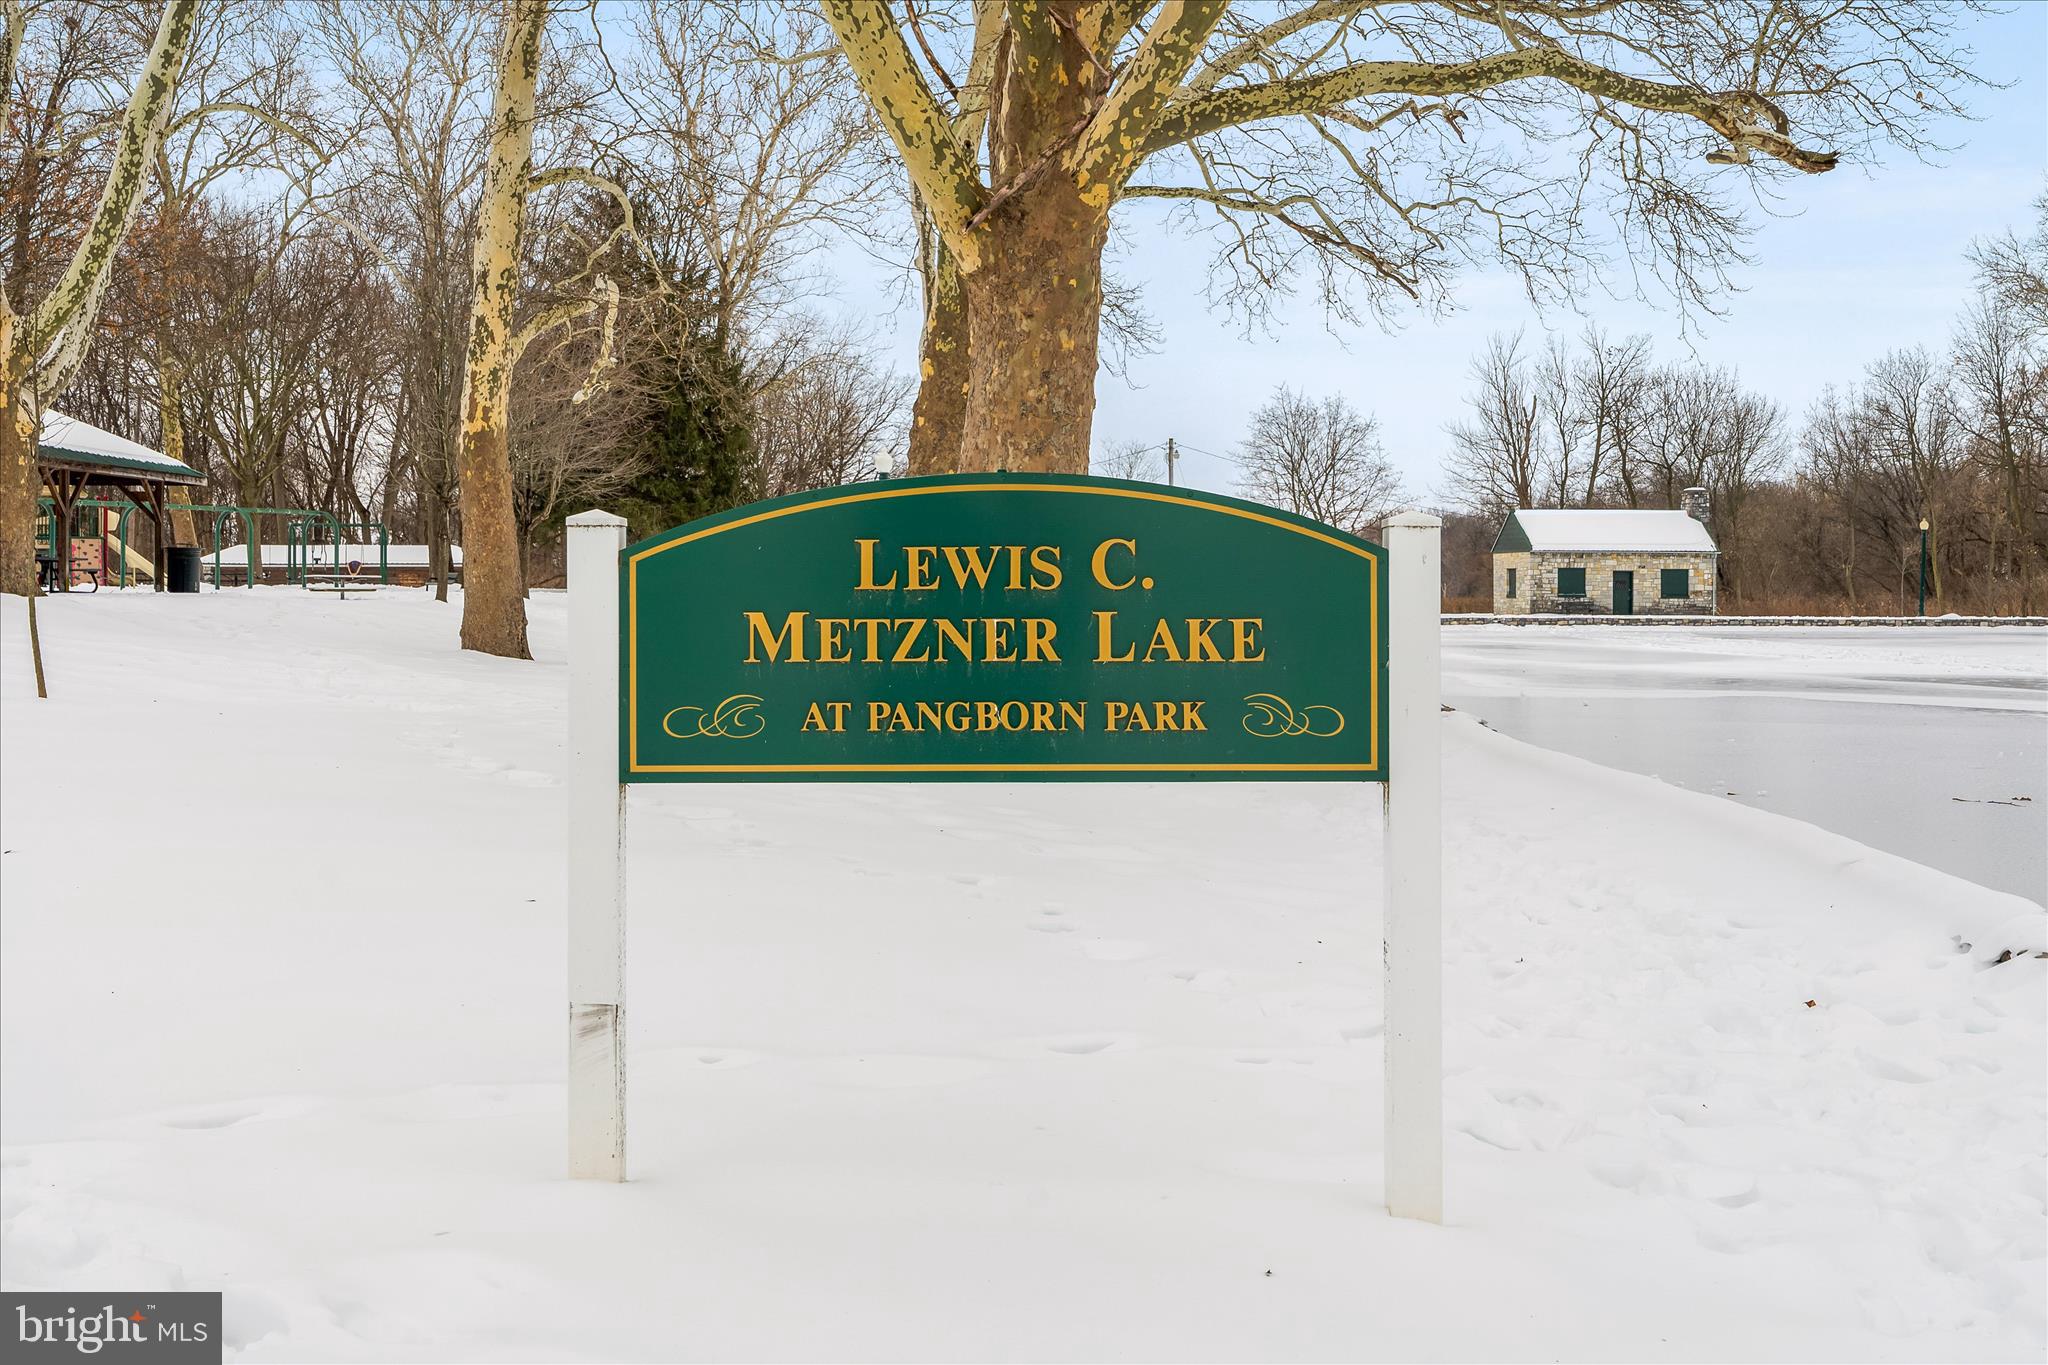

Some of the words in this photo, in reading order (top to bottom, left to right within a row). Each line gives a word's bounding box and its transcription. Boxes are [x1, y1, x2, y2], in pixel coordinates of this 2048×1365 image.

[855, 539, 1062, 591] LEWIS
[1091, 538, 1154, 591] C.
[744, 611, 1060, 663] METZNER
[1094, 611, 1265, 663] LAKE
[800, 701, 852, 732] AT
[867, 701, 1085, 732] PANGBORN
[1104, 701, 1206, 732] PARK
